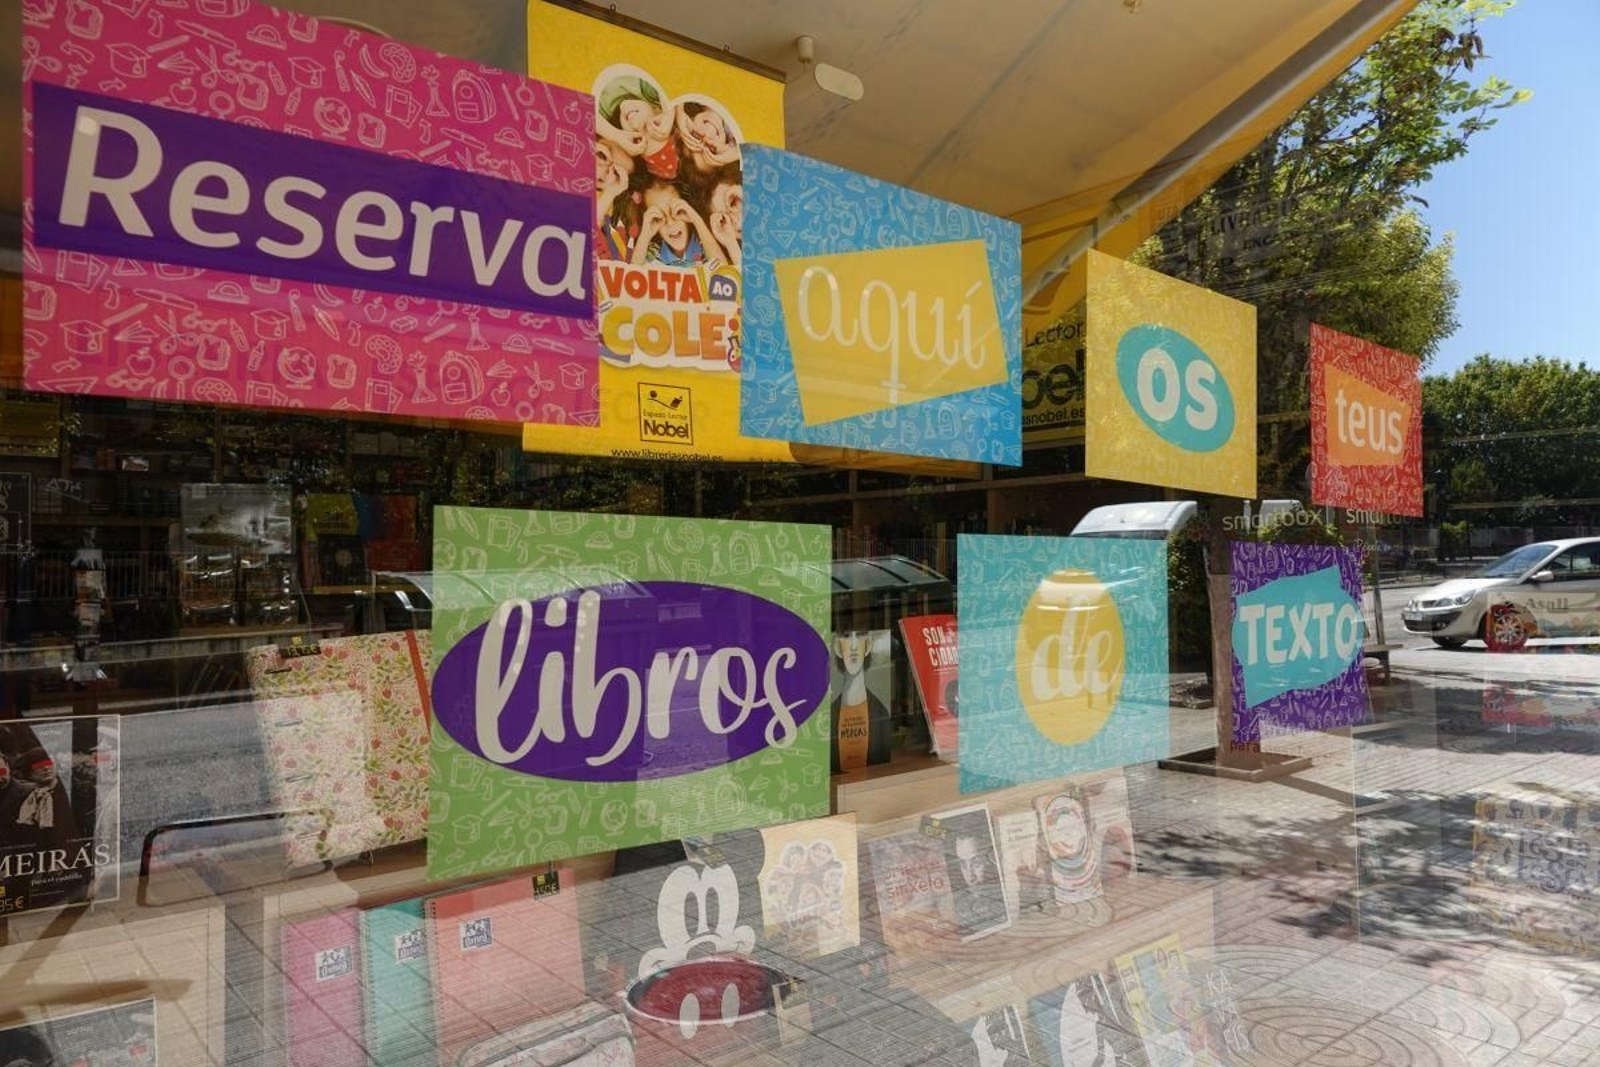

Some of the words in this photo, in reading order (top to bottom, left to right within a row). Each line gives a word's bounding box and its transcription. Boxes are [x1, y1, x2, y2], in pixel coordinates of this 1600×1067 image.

[58, 105, 587, 300] Reserva
[600, 266, 703, 303] VOLTA
[712, 281, 733, 297] AO
[602, 306, 727, 360] COLE
[798, 265, 987, 404] aquí
[644, 419, 689, 438] Nobel
[1335, 388, 1402, 455] teus
[1222, 508, 1323, 531] smartbox
[1031, 594, 1123, 699] de
[1239, 603, 1360, 666] TEXTO
[476, 590, 807, 766] libros
